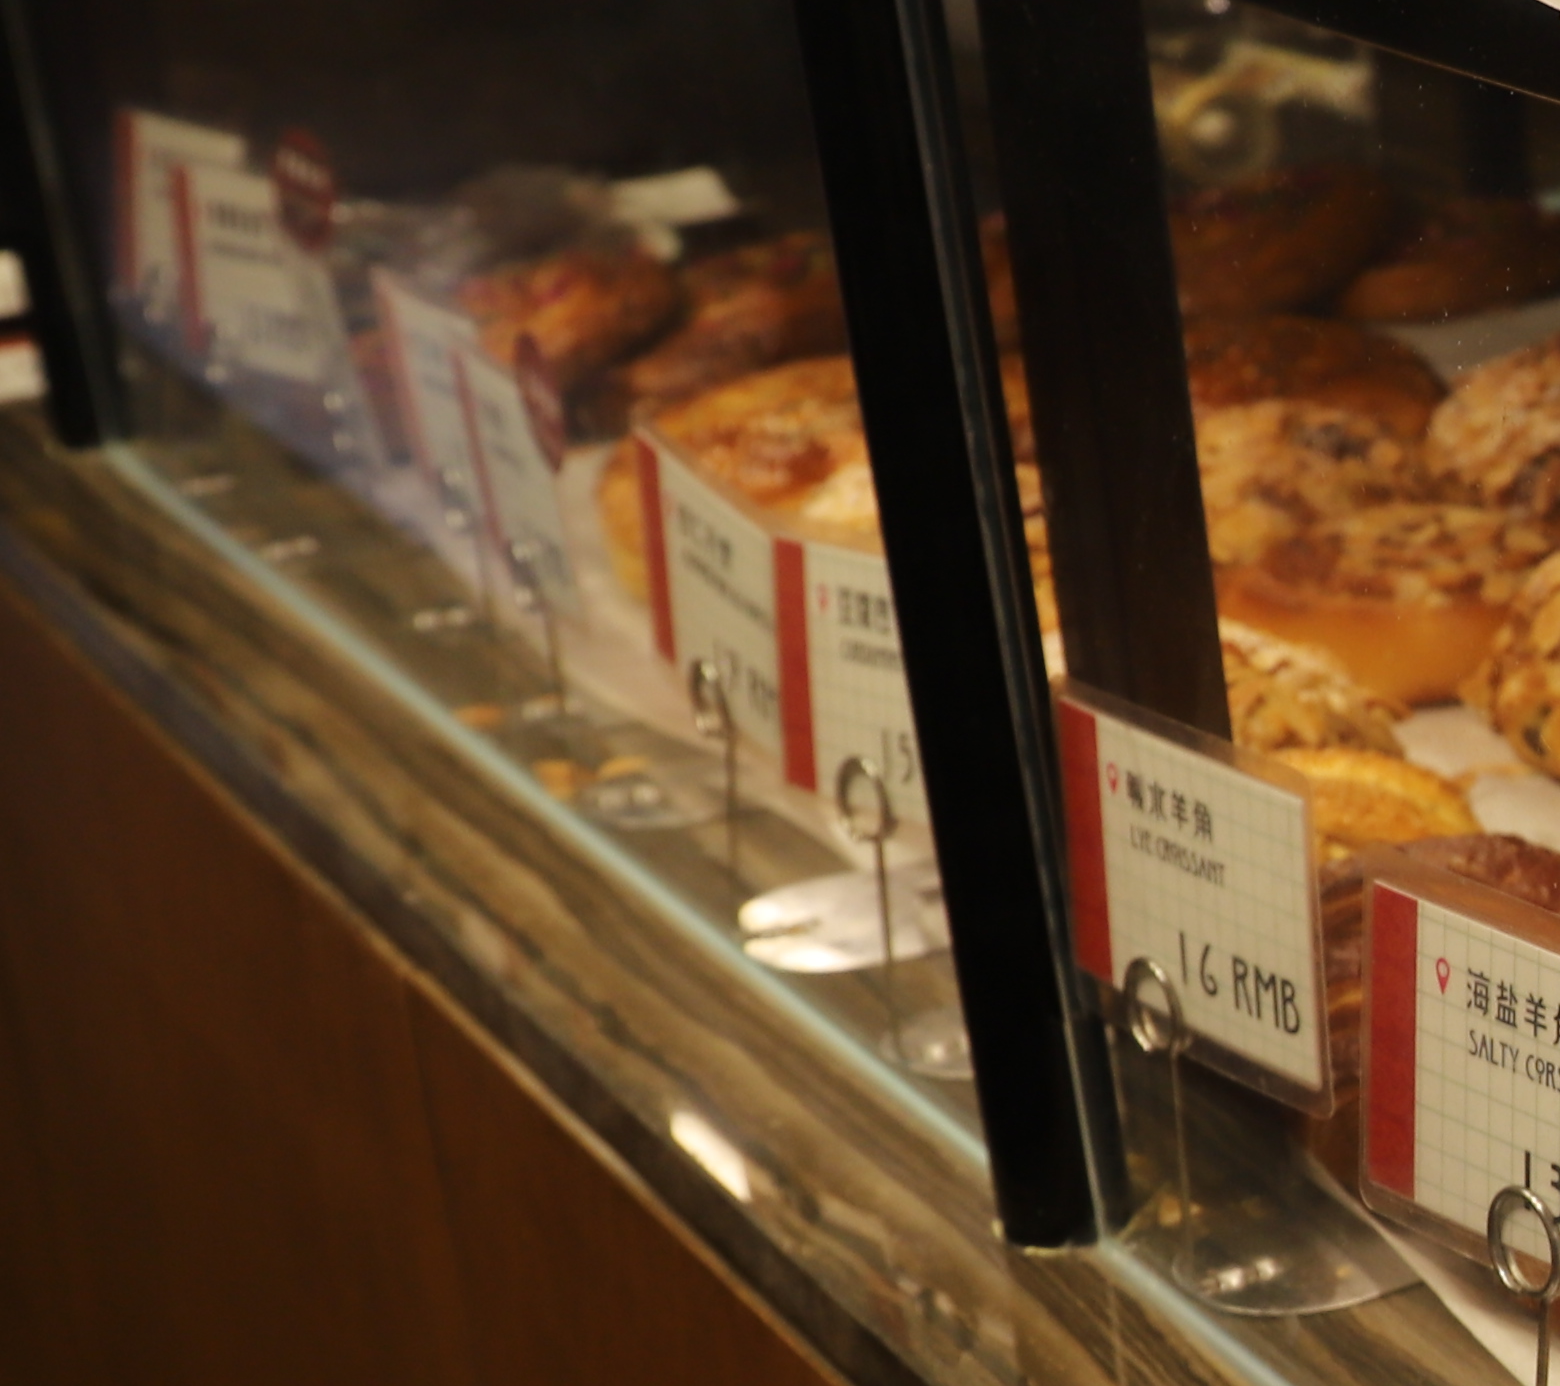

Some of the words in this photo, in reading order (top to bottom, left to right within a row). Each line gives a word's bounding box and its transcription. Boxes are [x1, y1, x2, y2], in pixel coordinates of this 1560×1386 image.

[1178, 929, 1218, 997] 16
[1232, 955, 1300, 1035] RMB
[1469, 1029, 1519, 1074] SALTY
